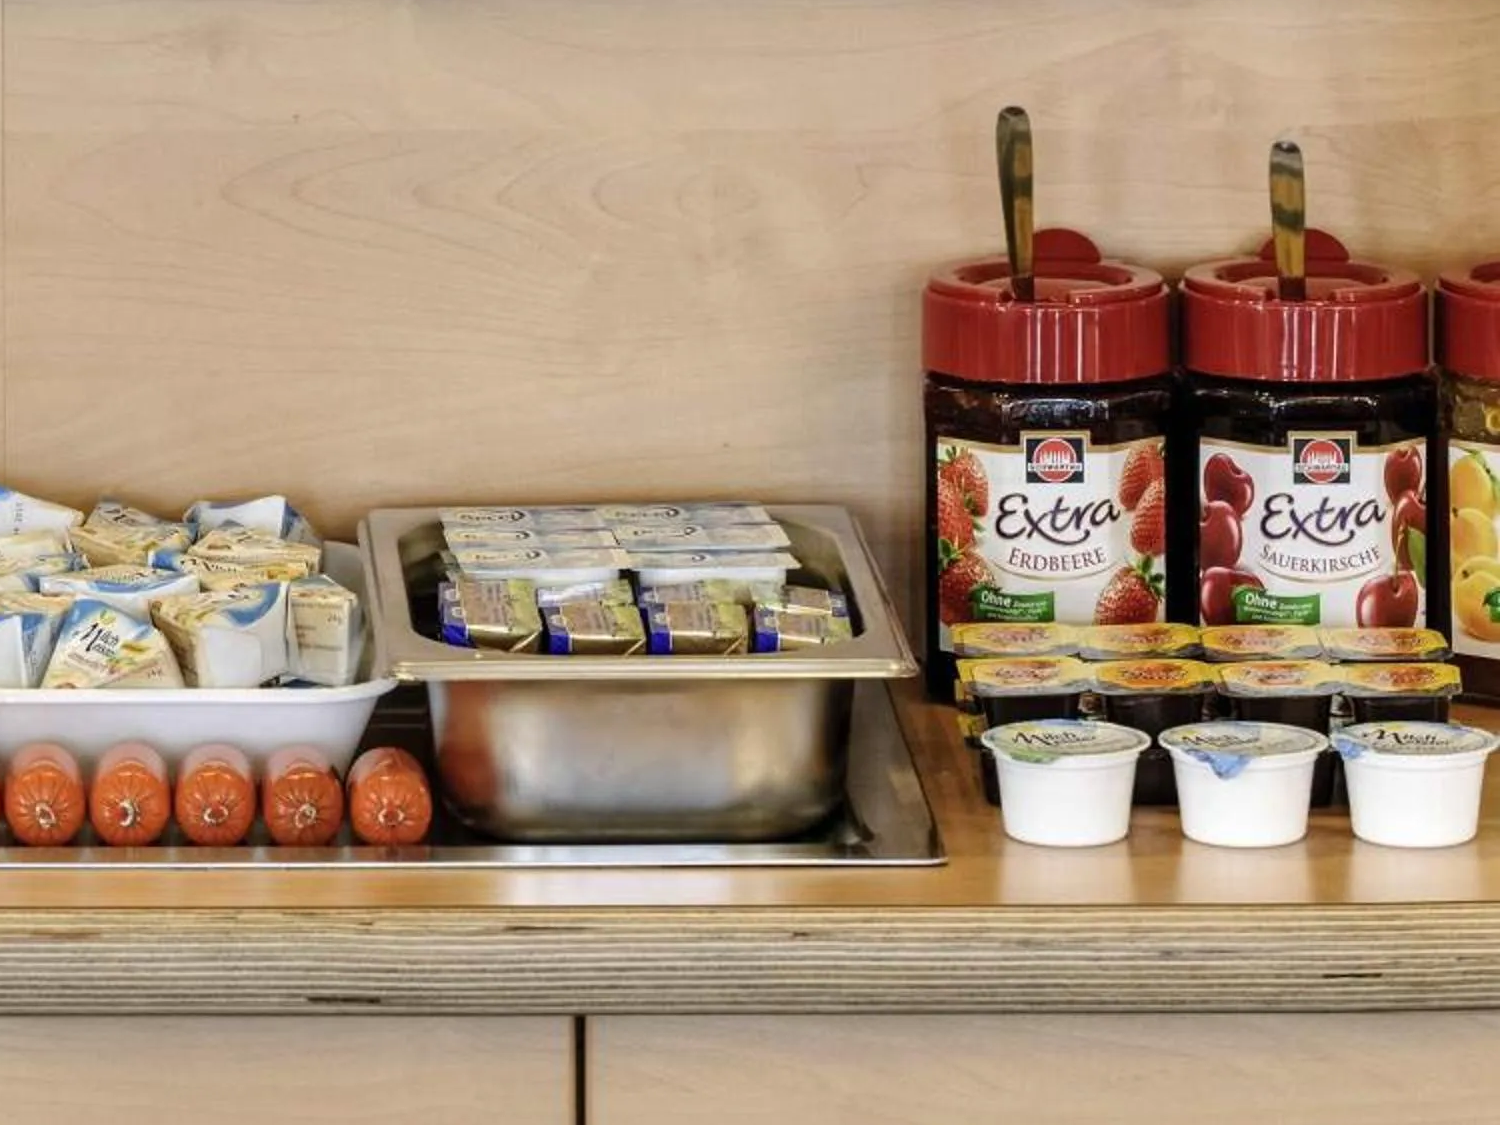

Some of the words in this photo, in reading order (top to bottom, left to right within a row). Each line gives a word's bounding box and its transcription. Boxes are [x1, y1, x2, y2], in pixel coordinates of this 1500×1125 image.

[995, 493, 1120, 546] Extra
[1260, 493, 1386, 547] Extra
[1008, 546, 1107, 572] ERDBEERE
[1260, 544, 1382, 574] SAUERKIRSCHE
